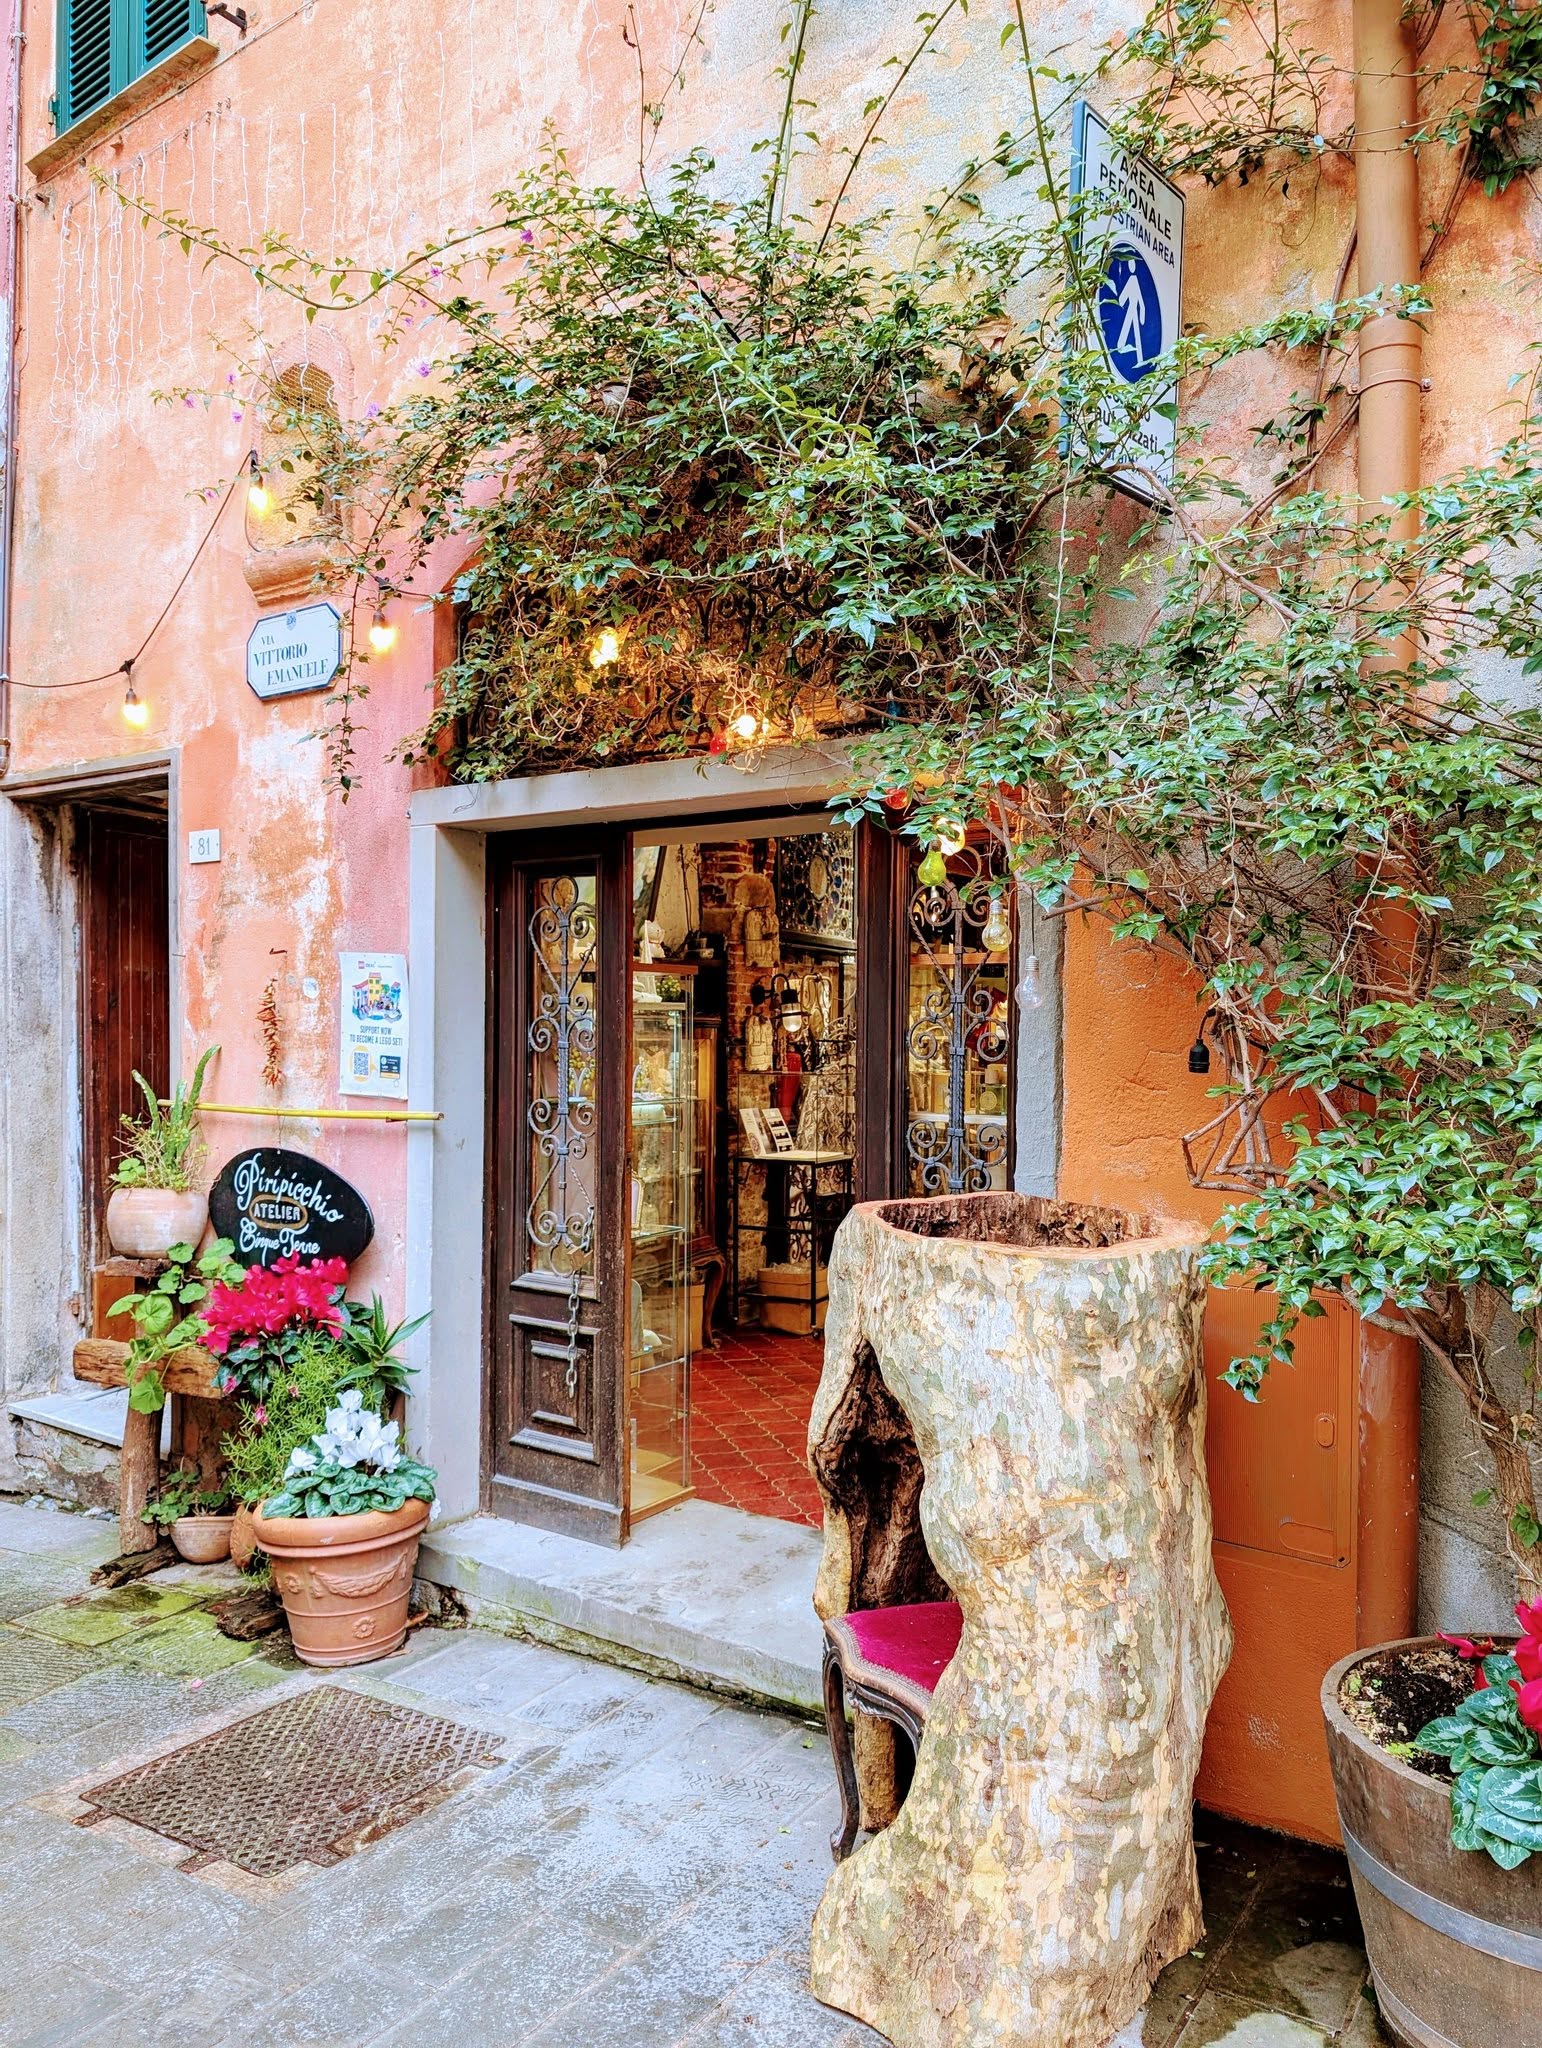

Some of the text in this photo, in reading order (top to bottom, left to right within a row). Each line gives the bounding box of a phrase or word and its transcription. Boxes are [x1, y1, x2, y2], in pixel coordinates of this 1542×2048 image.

[1120, 155, 1156, 202] AREA
[1099, 162, 1172, 241] PEDONALE
[1152, 237, 1175, 269] AREA
[253, 642, 308, 667] VITTORIO
[261, 635, 275, 646] VIA
[267, 658, 329, 686] EMANUELE
[197, 837, 210, 856] 81
[360, 1025, 380, 1034] SUPPORT
[233, 1152, 345, 1223] Piripicchio
[253, 1203, 301, 1221] ATELIER
[239, 1217, 321, 1267] Cinque Terre
